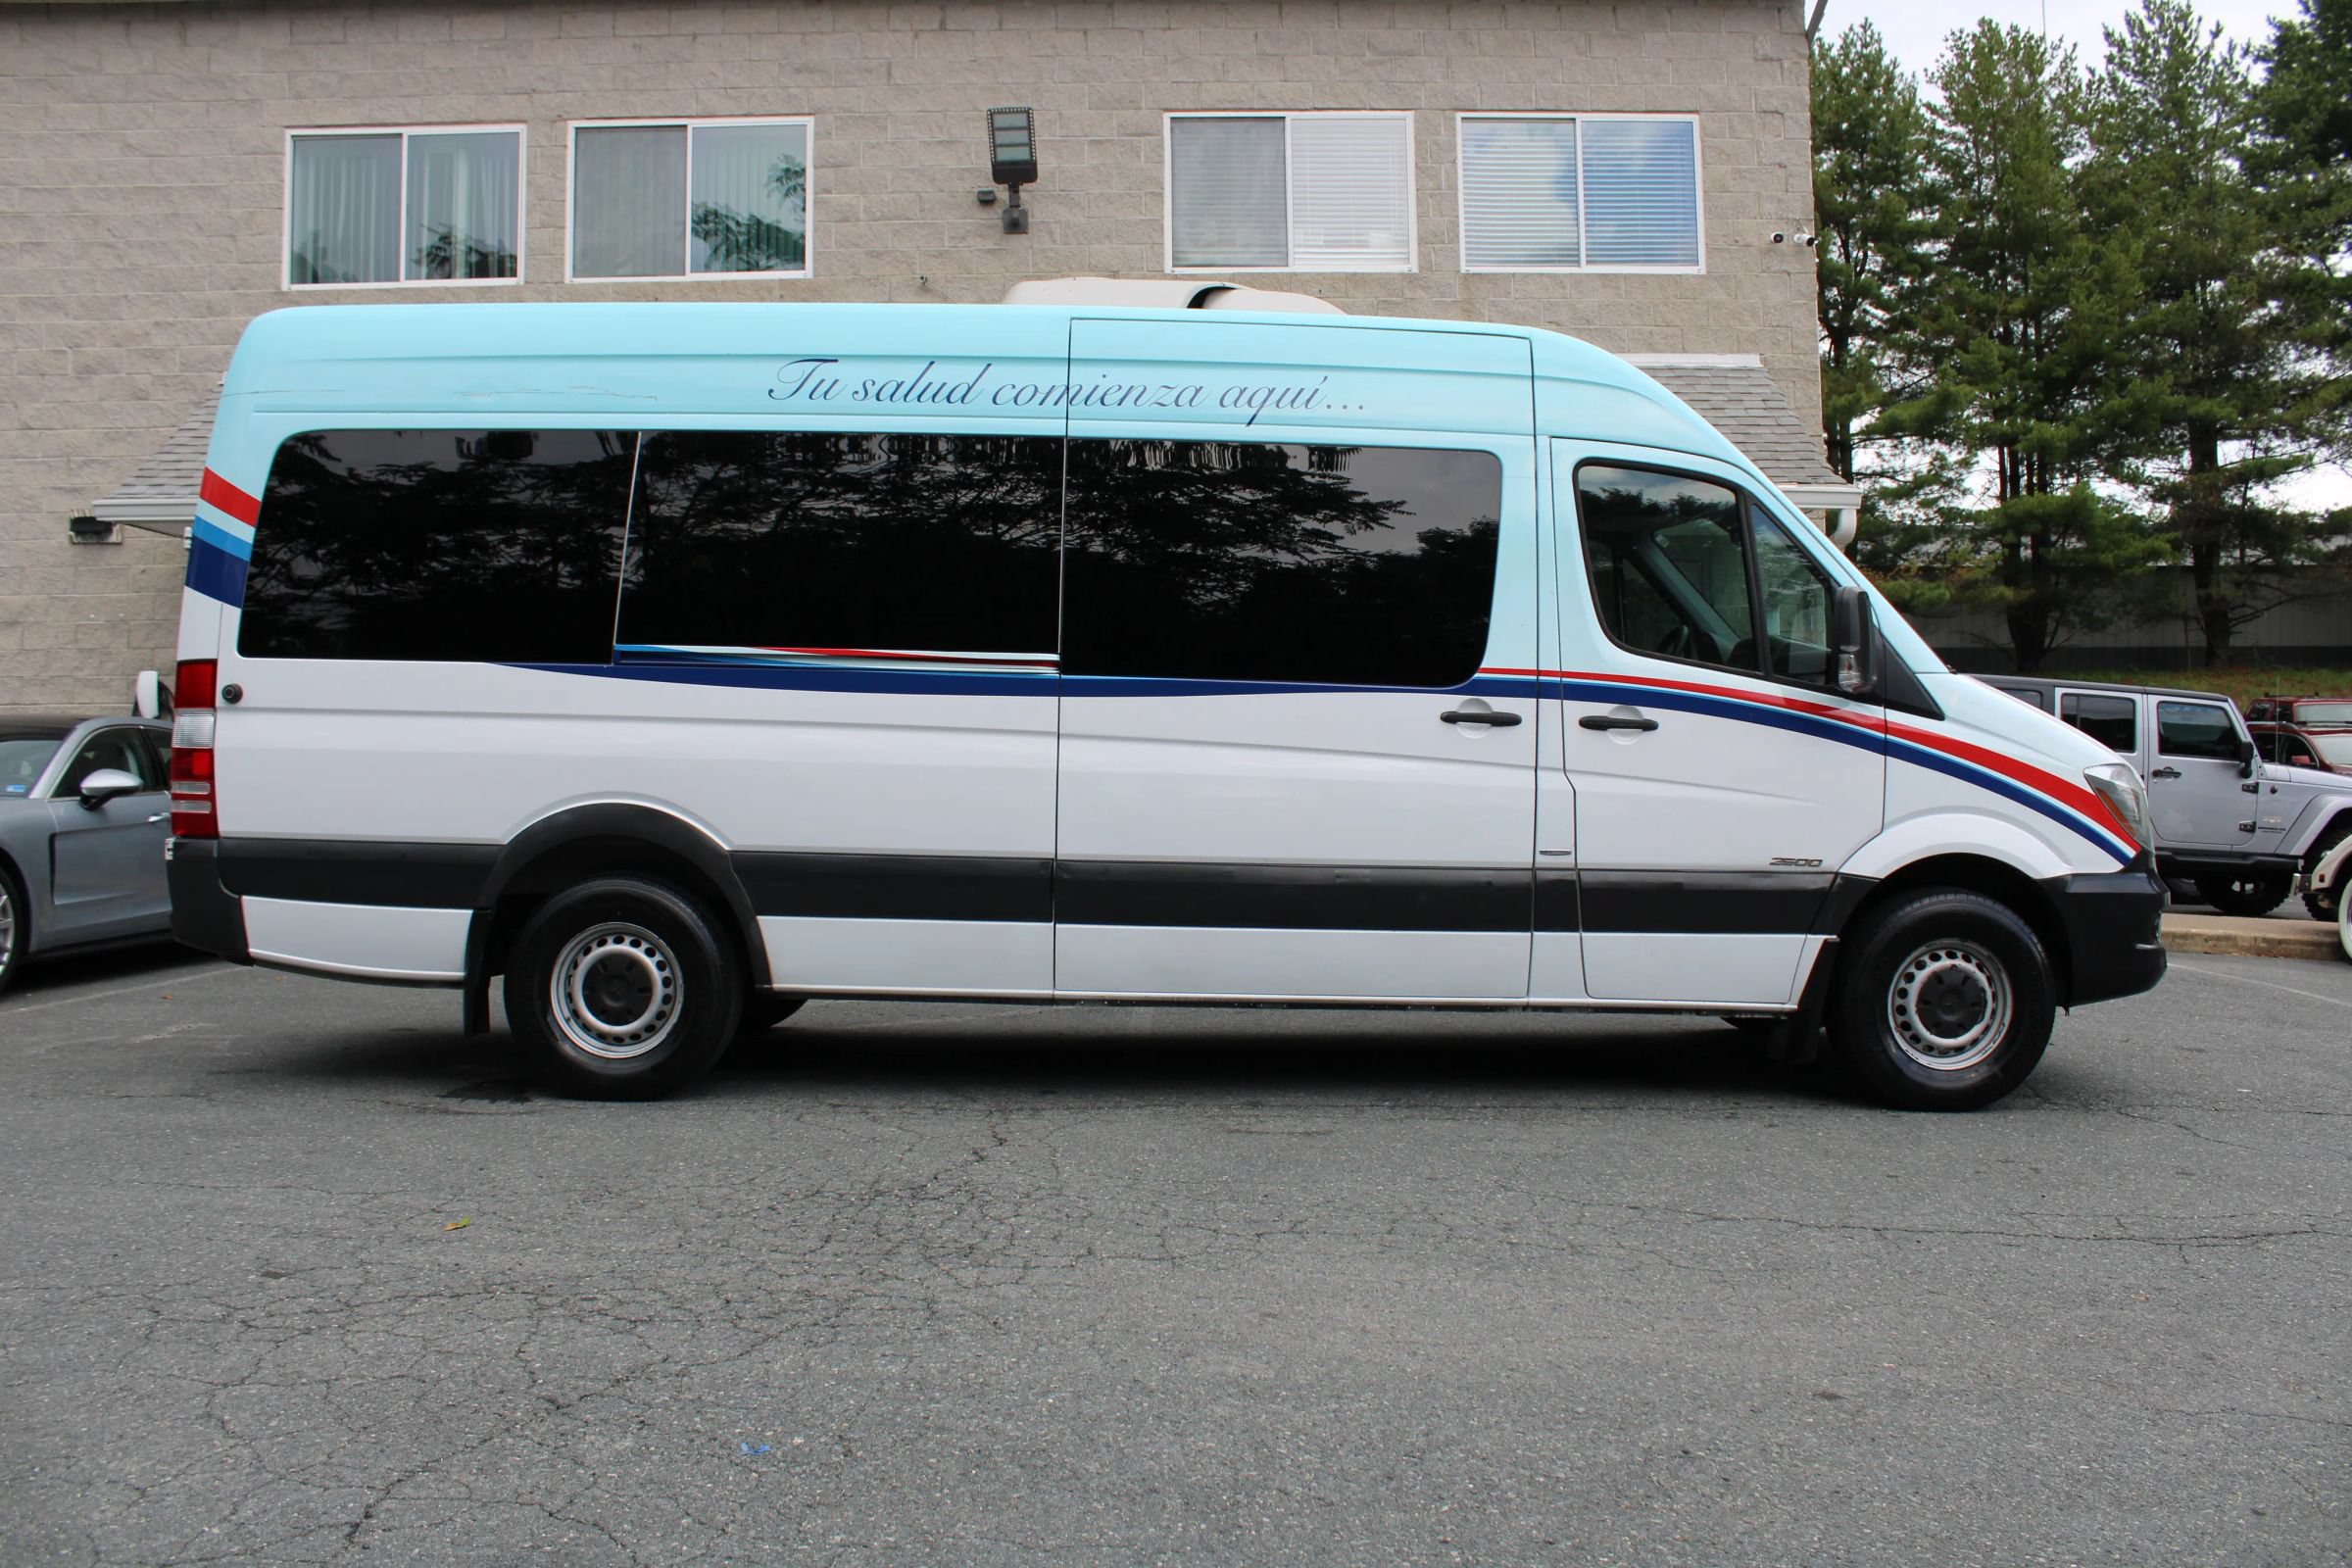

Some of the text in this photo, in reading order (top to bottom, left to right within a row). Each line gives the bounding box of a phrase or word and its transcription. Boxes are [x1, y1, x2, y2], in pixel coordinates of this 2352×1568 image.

[768, 359, 842, 401] Tu
[852, 361, 993, 405] salud
[992, 374, 1206, 408] comienza
[1769, 857, 1823, 867] 2500
